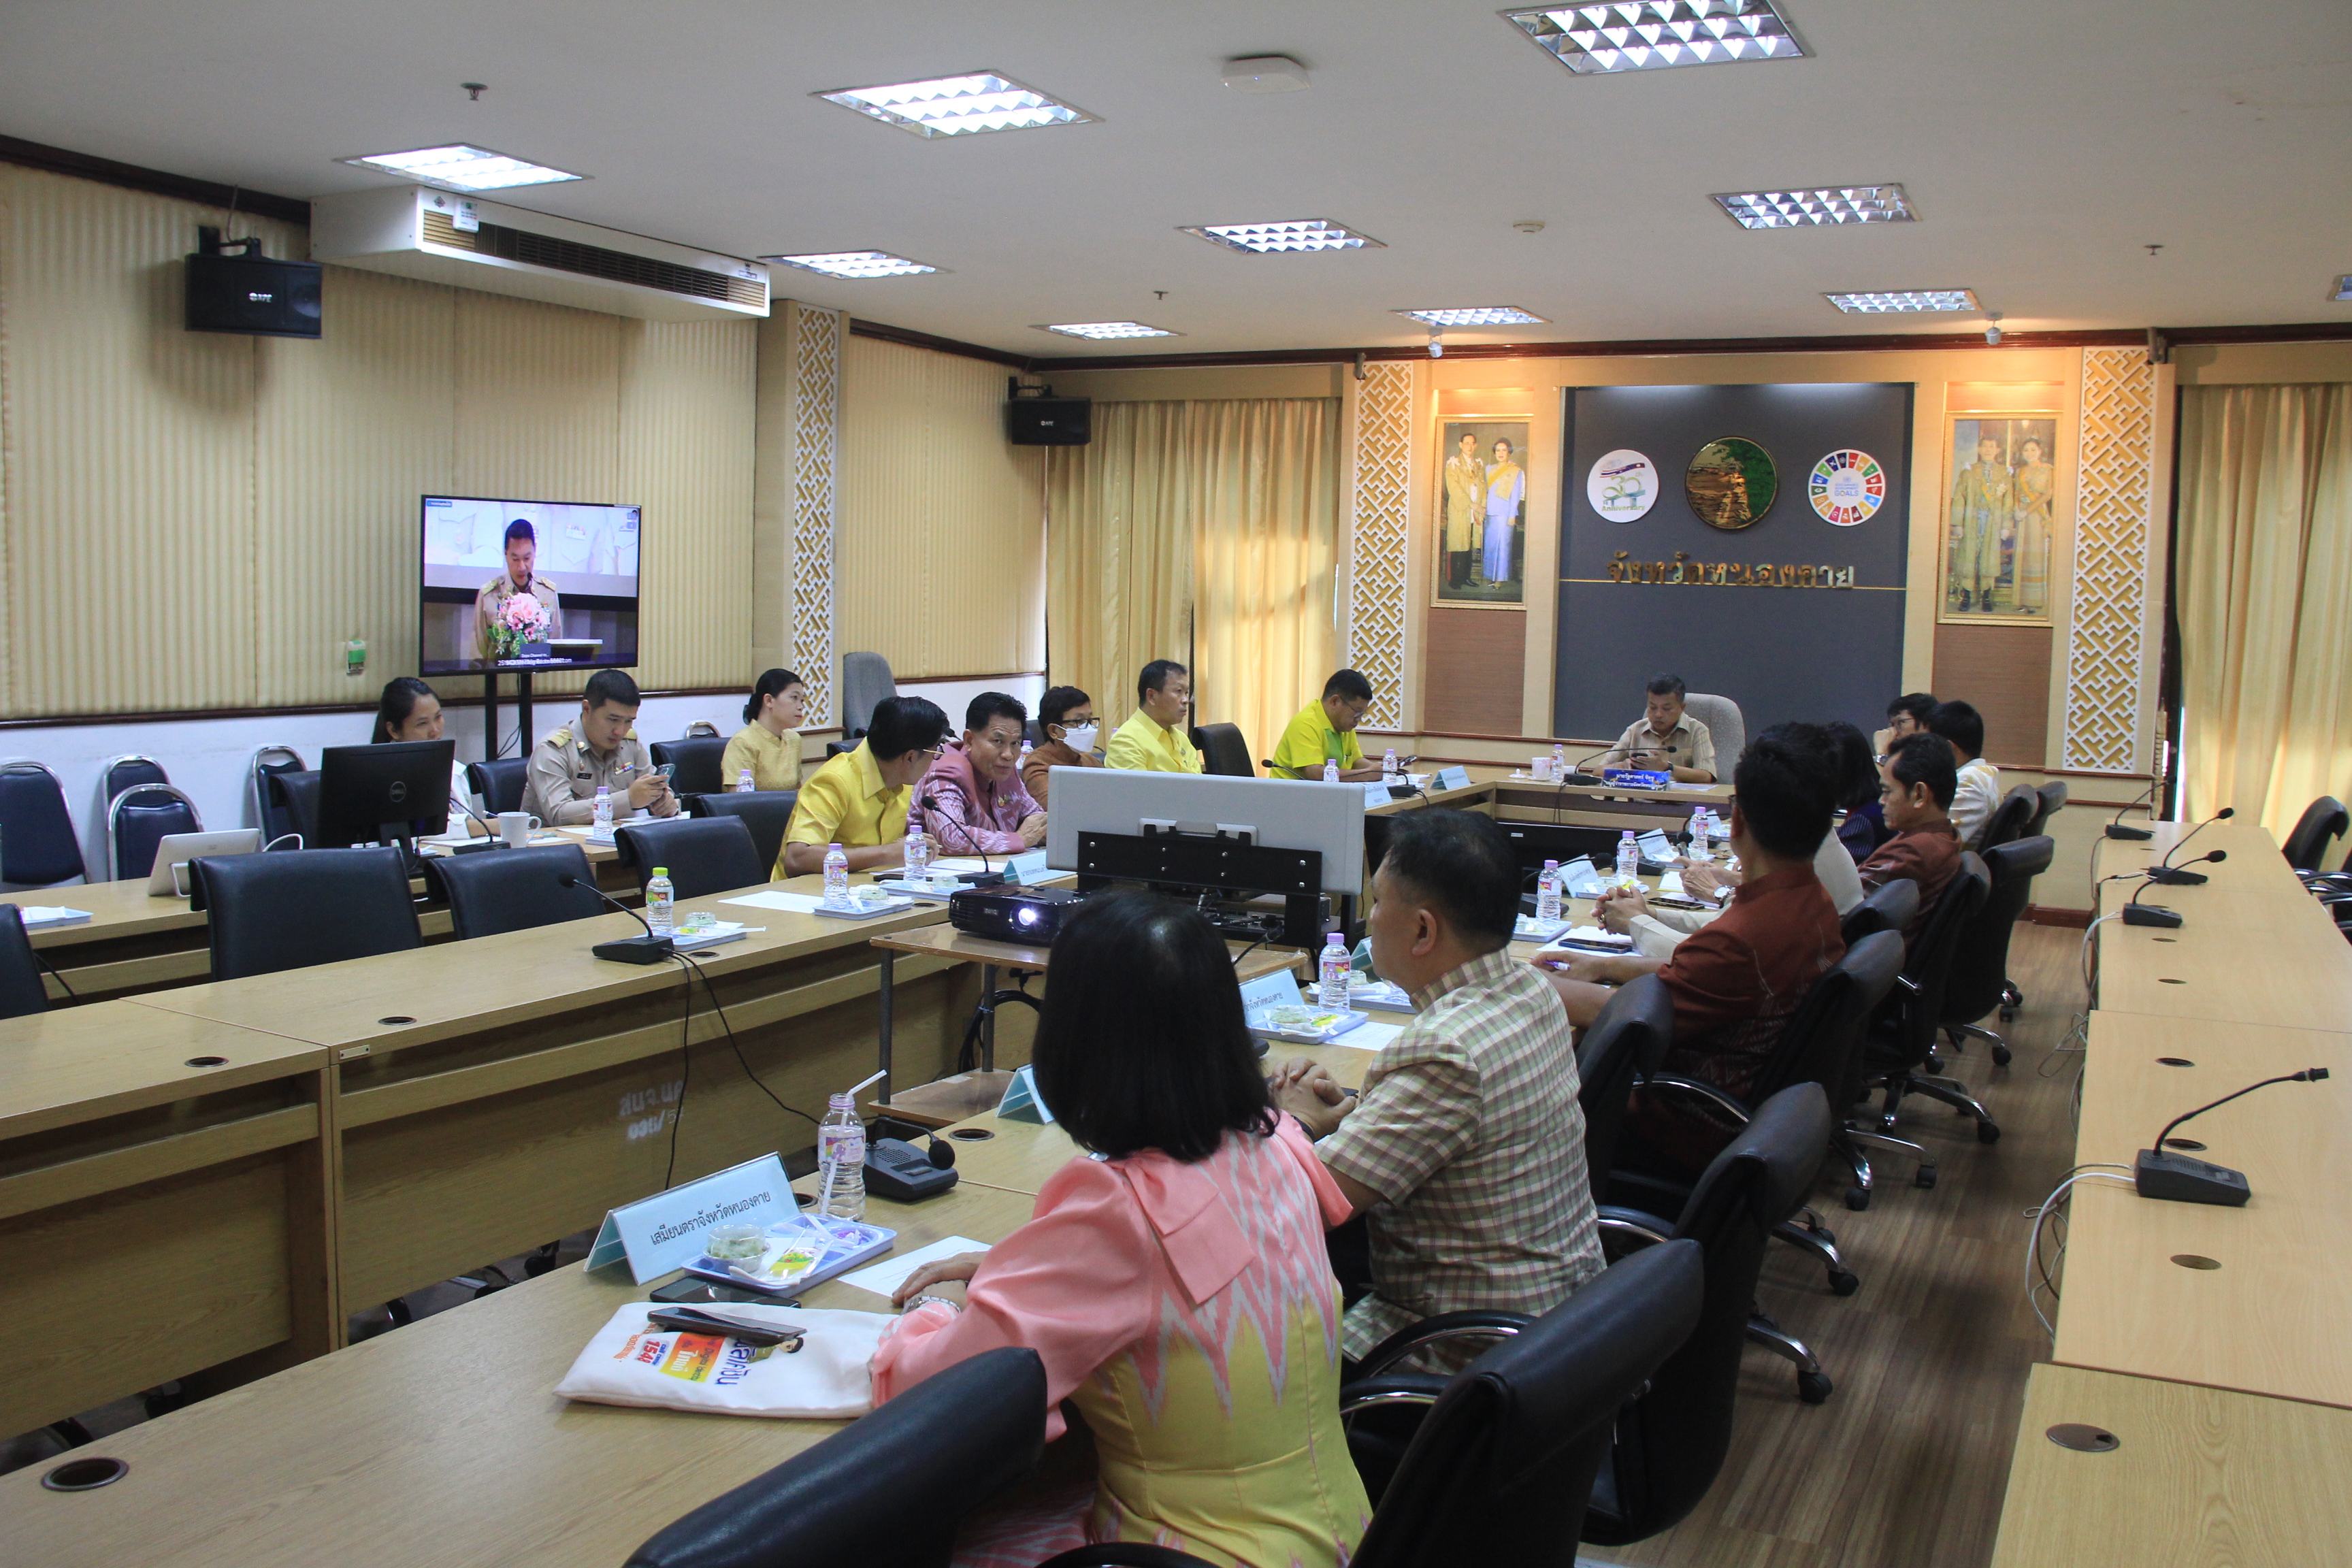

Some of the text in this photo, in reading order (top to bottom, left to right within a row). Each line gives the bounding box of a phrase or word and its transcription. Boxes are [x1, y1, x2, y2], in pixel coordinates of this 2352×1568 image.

[1607, 551, 1854, 588] จังหวัดหนองคาย
[651, 1191, 771, 1245] เสมียนตราจังหวัดหนองคาย
[636, 1341, 660, 1363] 1548
